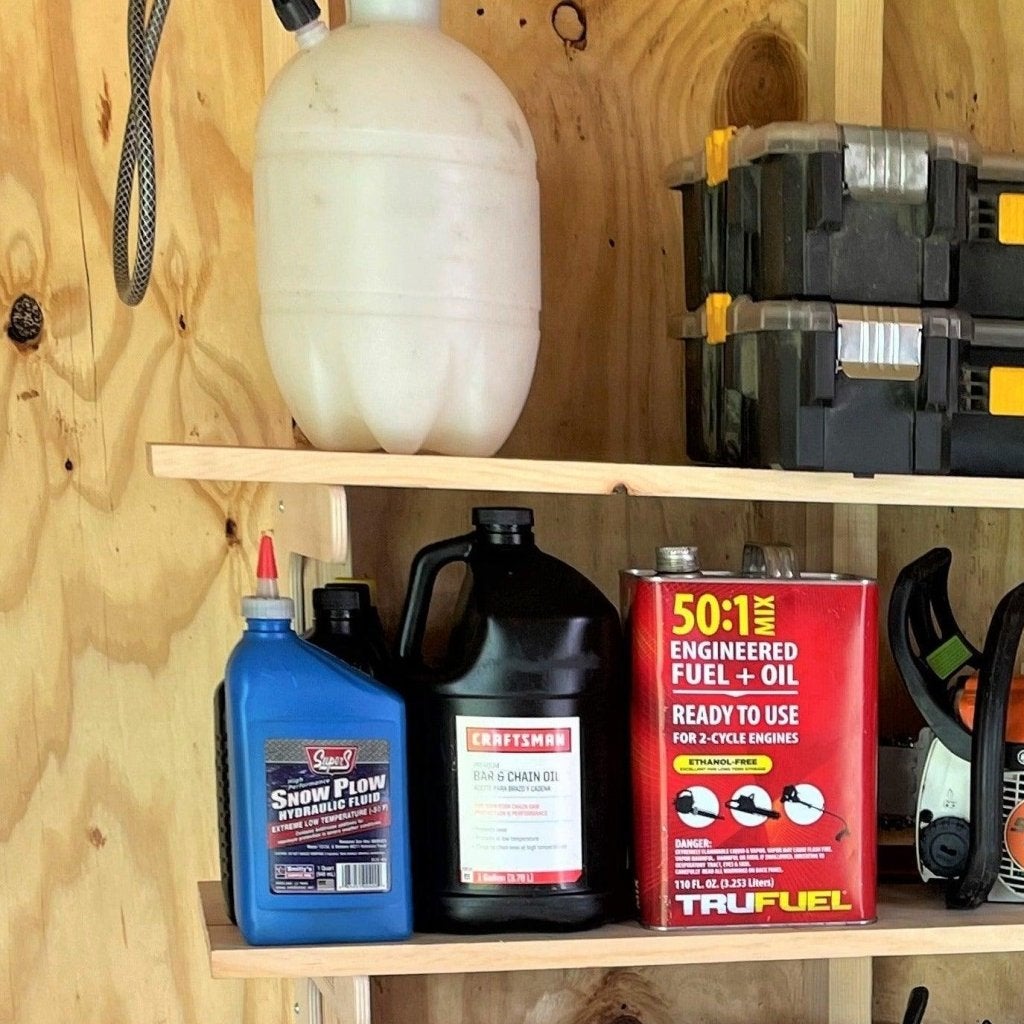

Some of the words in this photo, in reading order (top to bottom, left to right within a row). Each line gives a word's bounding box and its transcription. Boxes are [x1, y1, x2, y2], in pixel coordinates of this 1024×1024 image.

[672, 593, 749, 636] 50:1
[754, 594, 776, 637] MIX
[670, 640, 798, 661] ENGINEERED
[671, 663, 730, 685] FUEL
[735, 668, 755, 685] +
[761, 664, 799, 686] OIL
[672, 705, 734, 725] READY
[737, 705, 761, 725] TO
[765, 705, 799, 725] USE
[472, 733, 566, 748] CRAFTSMAN
[672, 732, 697, 744] FOR
[699, 732, 746, 744] 2-CYCLE
[748, 732, 799, 744] ENGINES
[688, 758, 758, 766] ETHANOL-FREE
[474, 771, 494, 781] BAR
[497, 771, 505, 781] &
[507, 771, 541, 782] CHAIN
[543, 771, 559, 781] OIL
[270, 785, 331, 810] SNOW
[333, 774, 387, 798] PLOW
[278, 799, 346, 821] HYDRAULIC
[348, 792, 381, 809] FLUID
[271, 821, 303, 834] EXTREME
[304, 818, 320, 828] LOW
[320, 807, 368, 824] TEMPERATURE
[674, 838, 713, 848] DANGER:
[674, 879, 691, 889] 110
[692, 879, 705, 889] FL.
[675, 889, 852, 916] TRUFUEL
